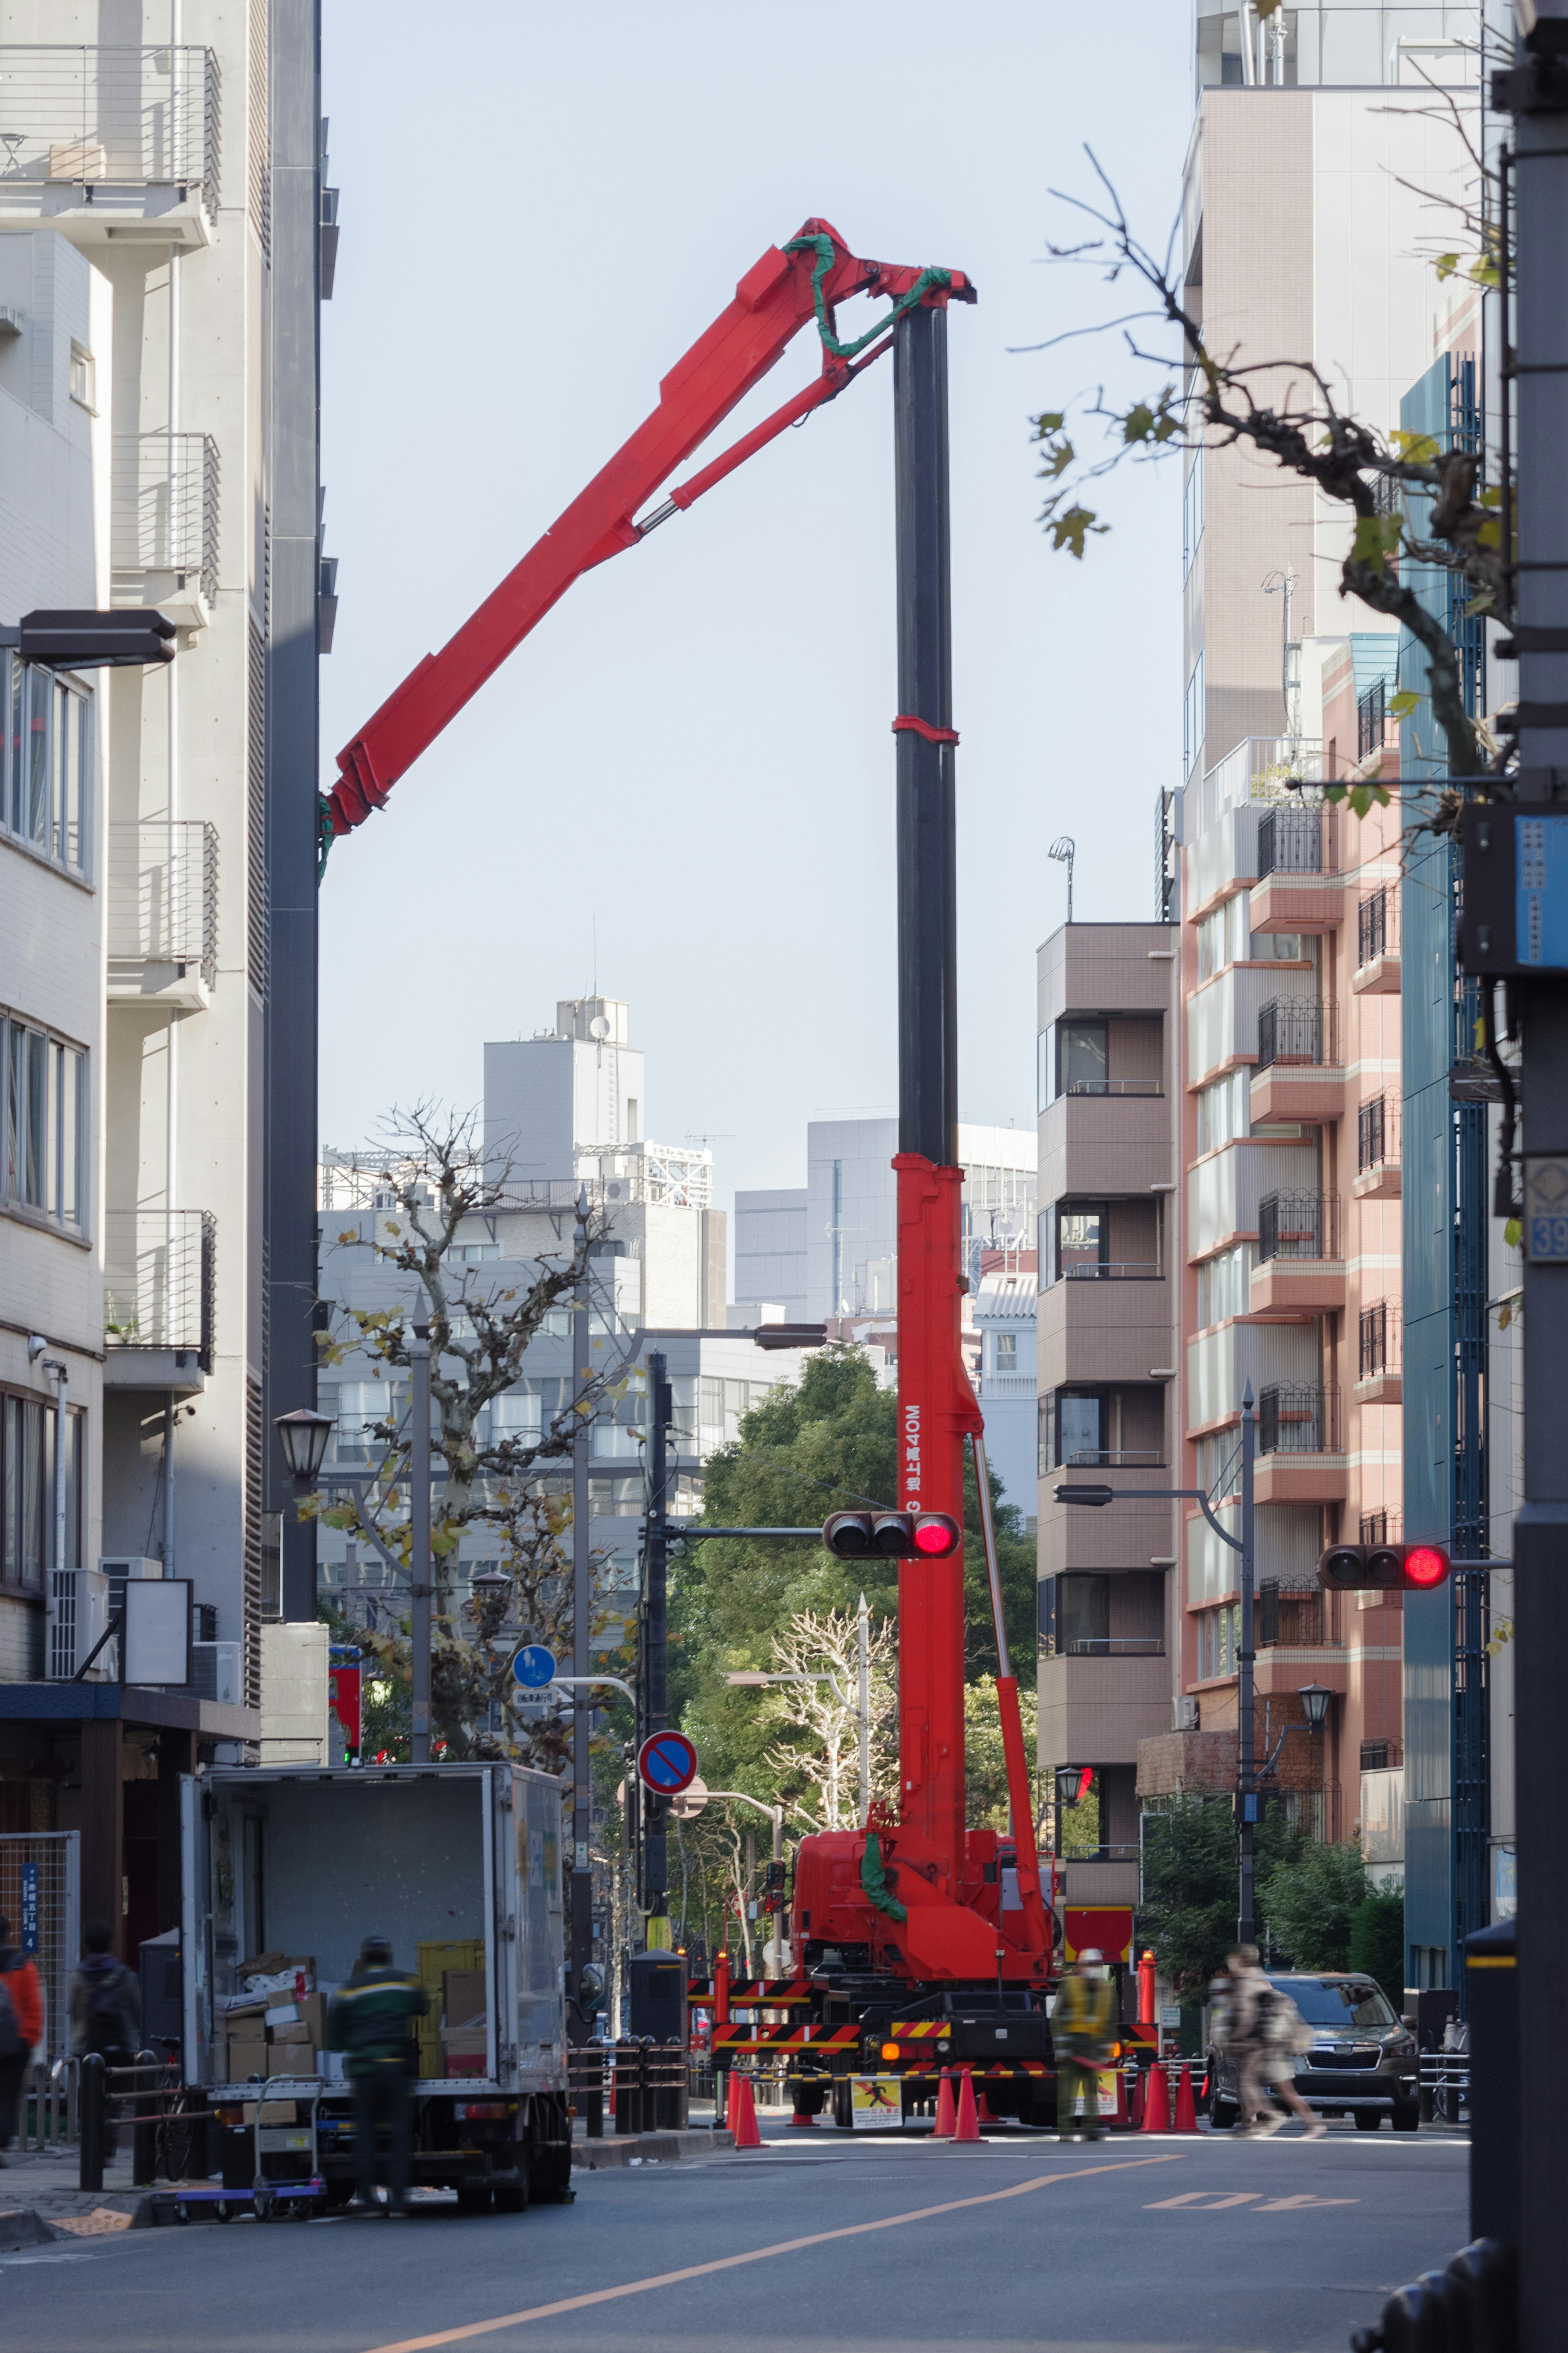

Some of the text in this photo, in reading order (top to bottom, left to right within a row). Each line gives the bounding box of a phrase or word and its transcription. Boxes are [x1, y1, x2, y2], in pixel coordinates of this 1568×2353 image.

[906, 1405, 921, 1491] 地上高40M
[27, 1937, 33, 1948] 4
